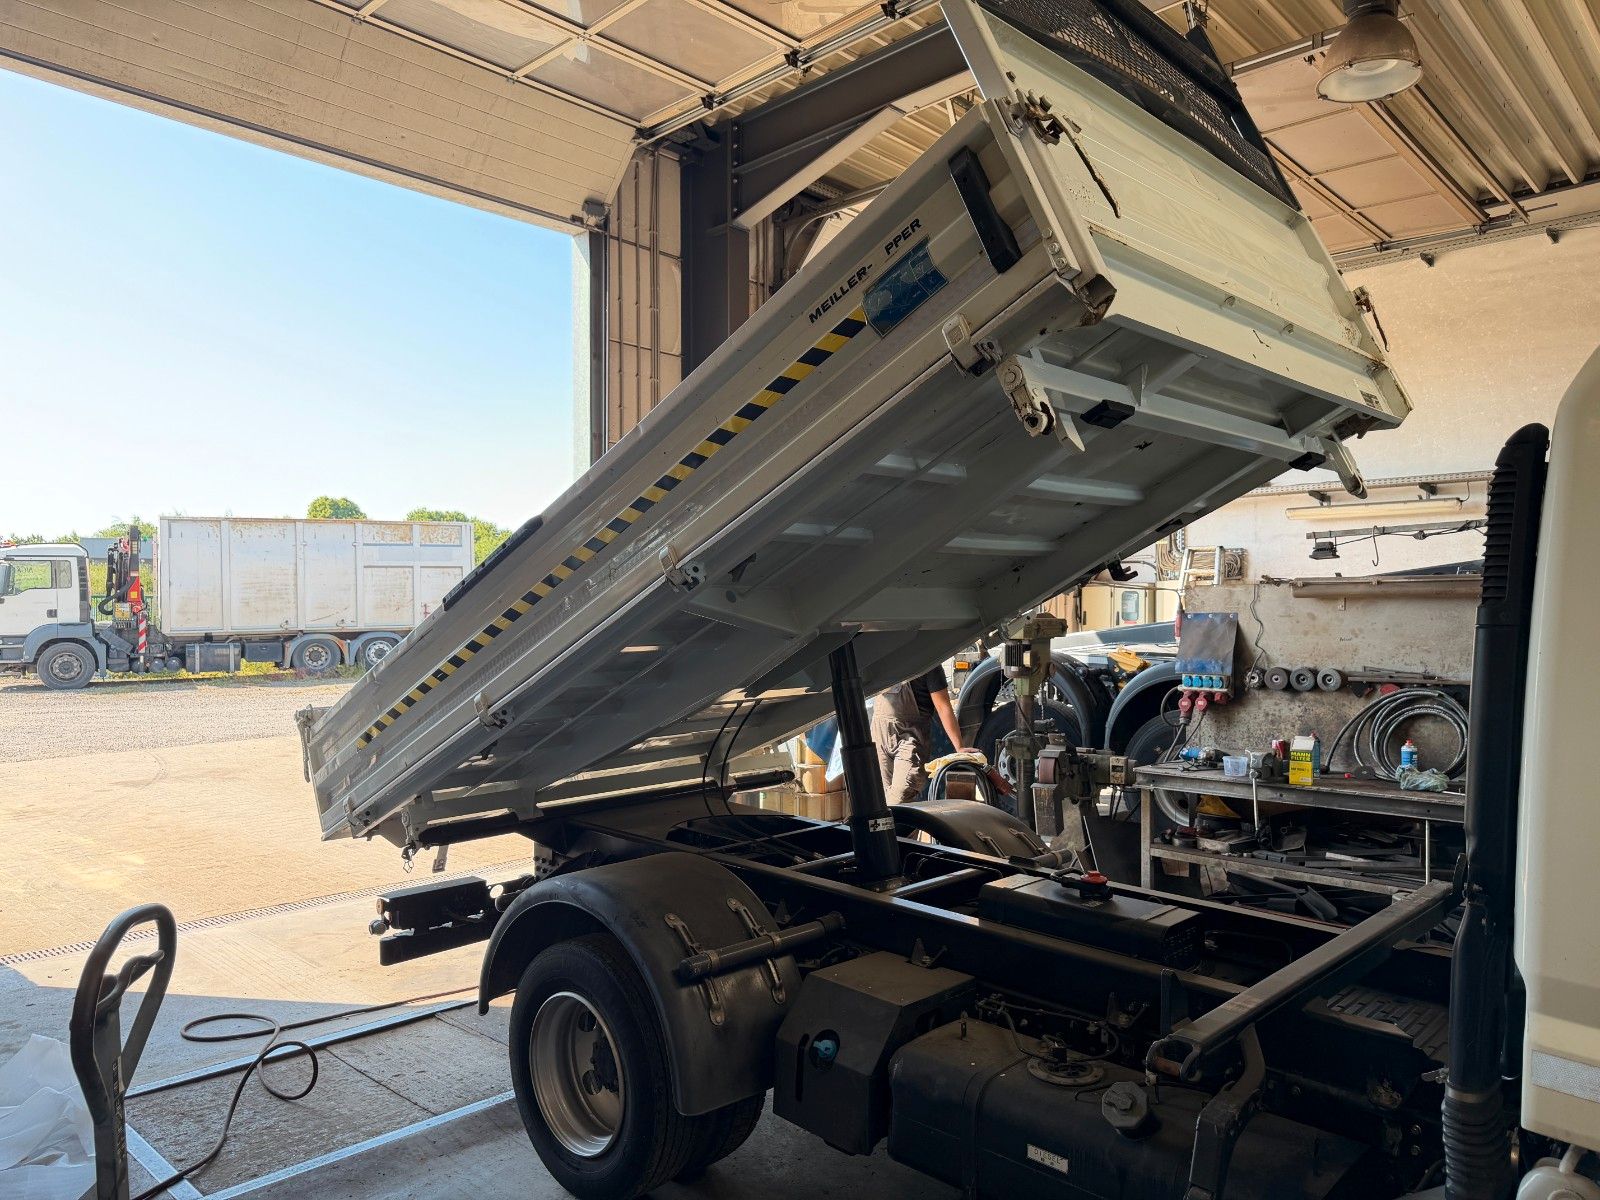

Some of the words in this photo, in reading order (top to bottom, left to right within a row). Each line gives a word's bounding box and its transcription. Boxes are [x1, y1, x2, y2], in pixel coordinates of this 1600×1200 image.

[808, 264, 873, 324] MEILLER-
[884, 218, 922, 256] PPER
[1034, 1148, 1061, 1165] DIESEL
